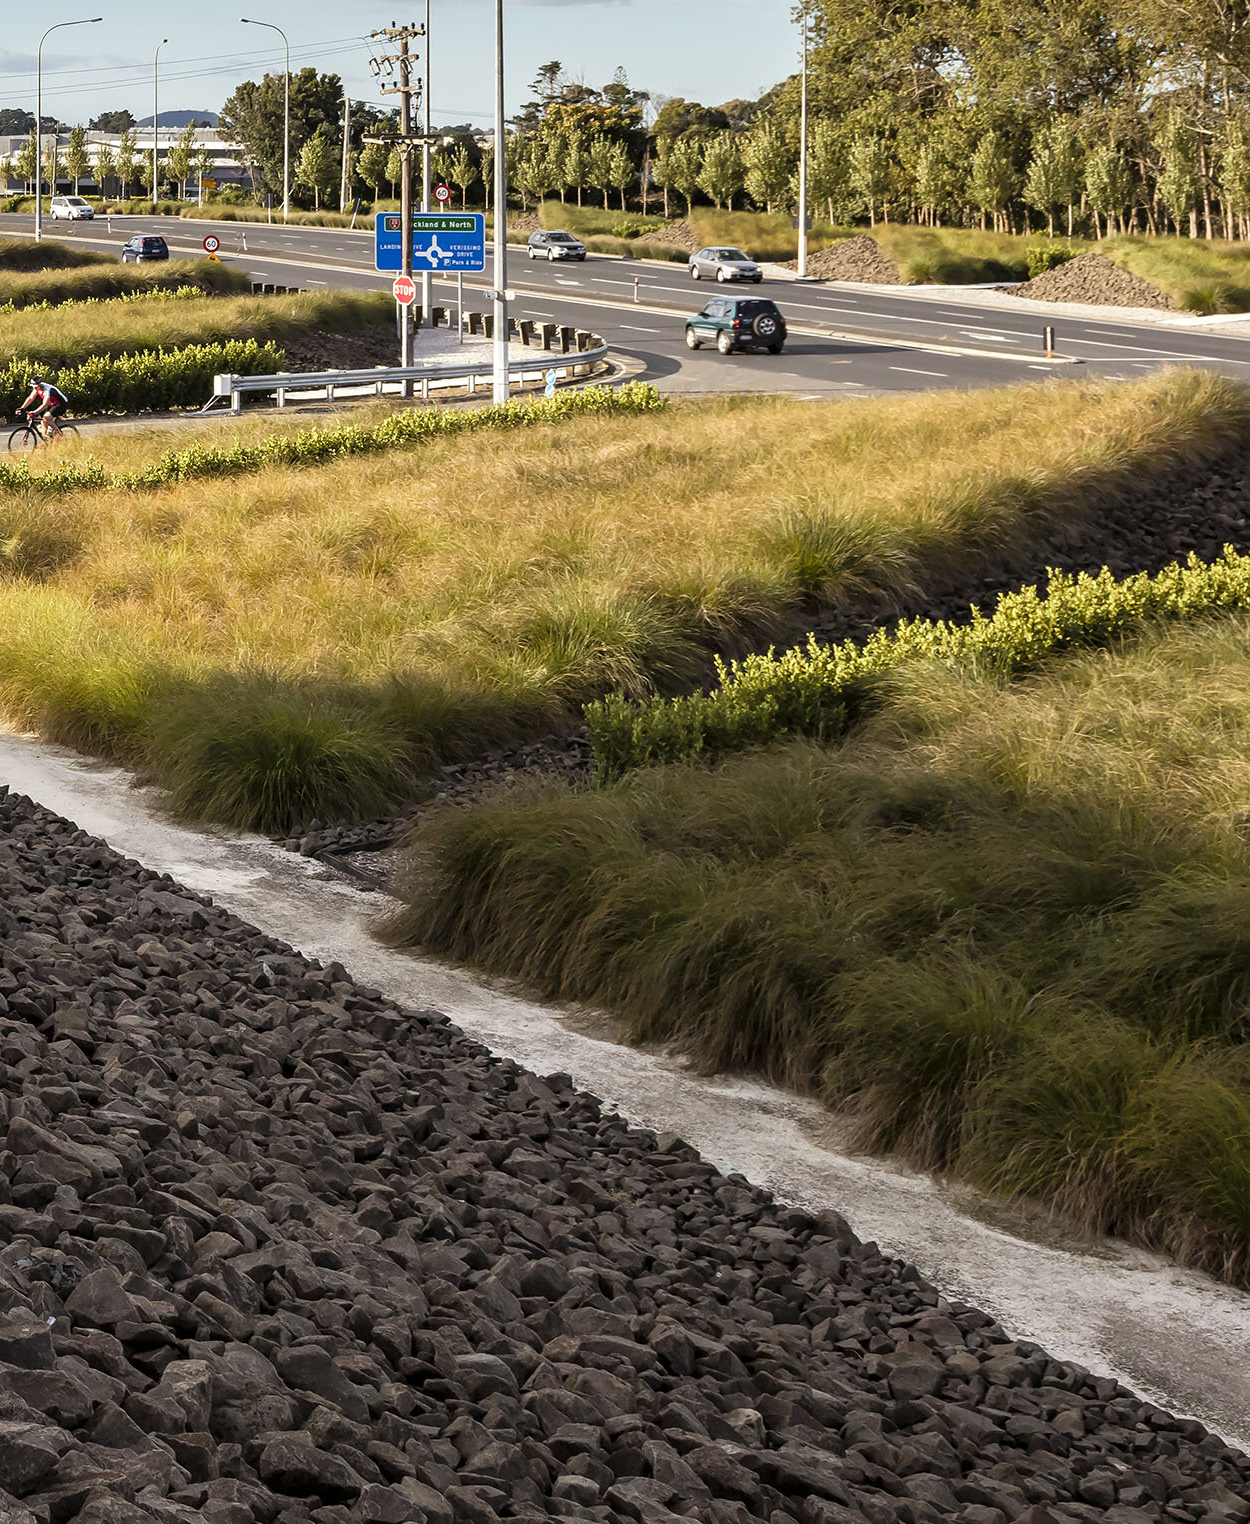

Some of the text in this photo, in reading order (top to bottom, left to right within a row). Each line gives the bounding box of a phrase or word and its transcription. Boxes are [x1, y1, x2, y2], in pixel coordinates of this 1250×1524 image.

[437, 189, 447, 197] 60
[206, 240, 216, 248] 60
[394, 285, 414, 296] STOP
